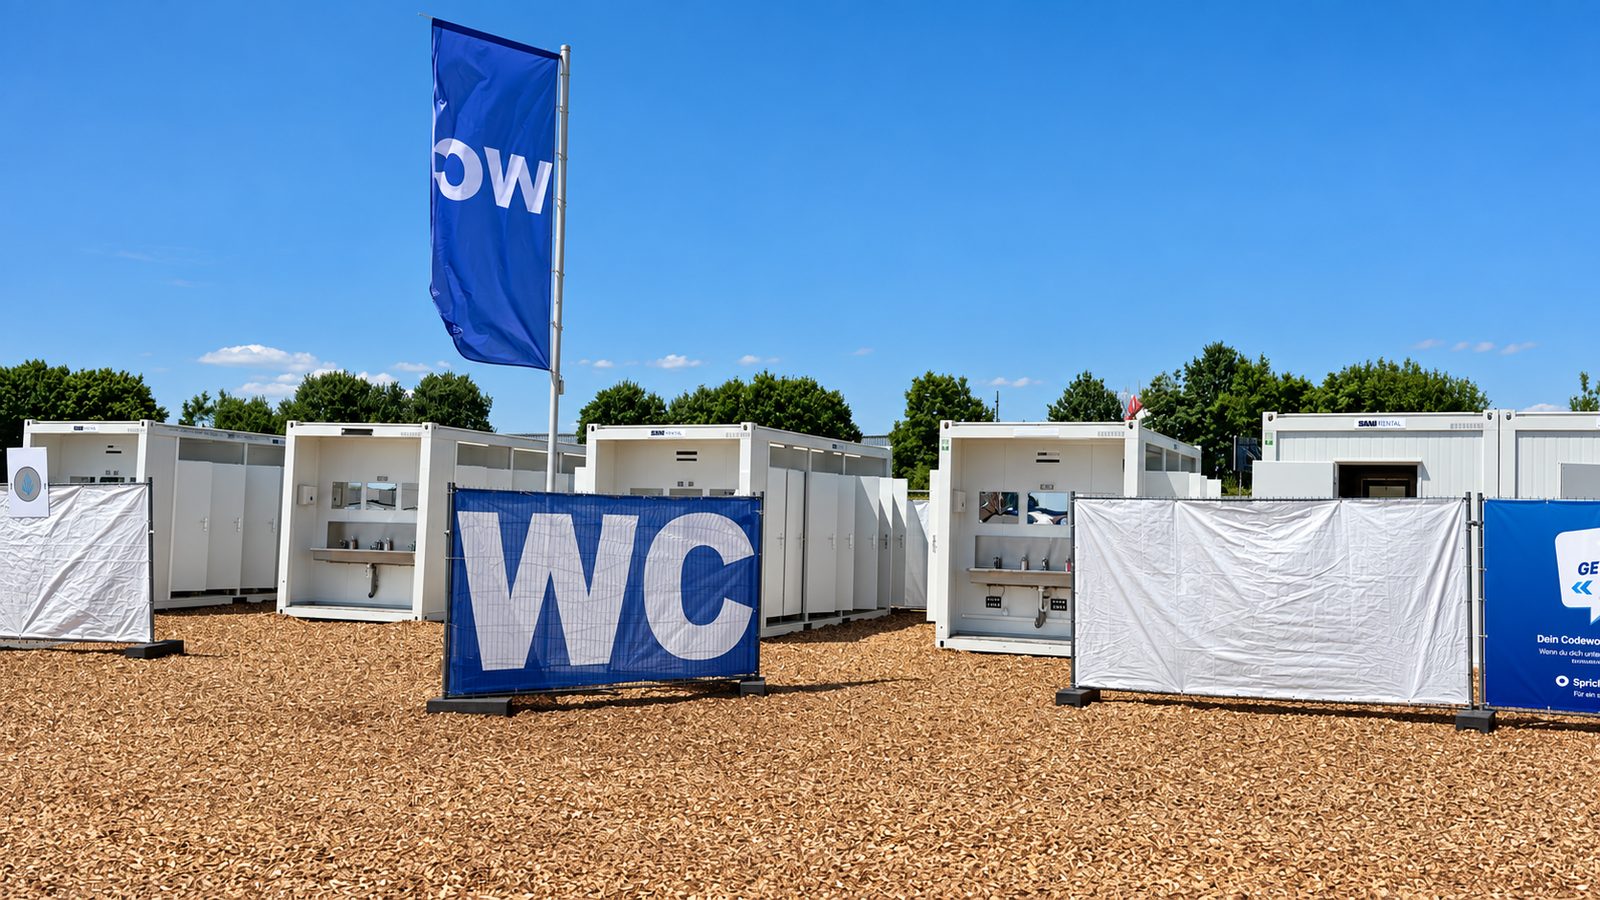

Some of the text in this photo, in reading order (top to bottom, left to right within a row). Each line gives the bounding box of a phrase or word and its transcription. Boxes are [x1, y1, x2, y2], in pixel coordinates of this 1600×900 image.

[456, 510, 755, 671] WC
[1537, 634, 1600, 646] Dein Codewo
